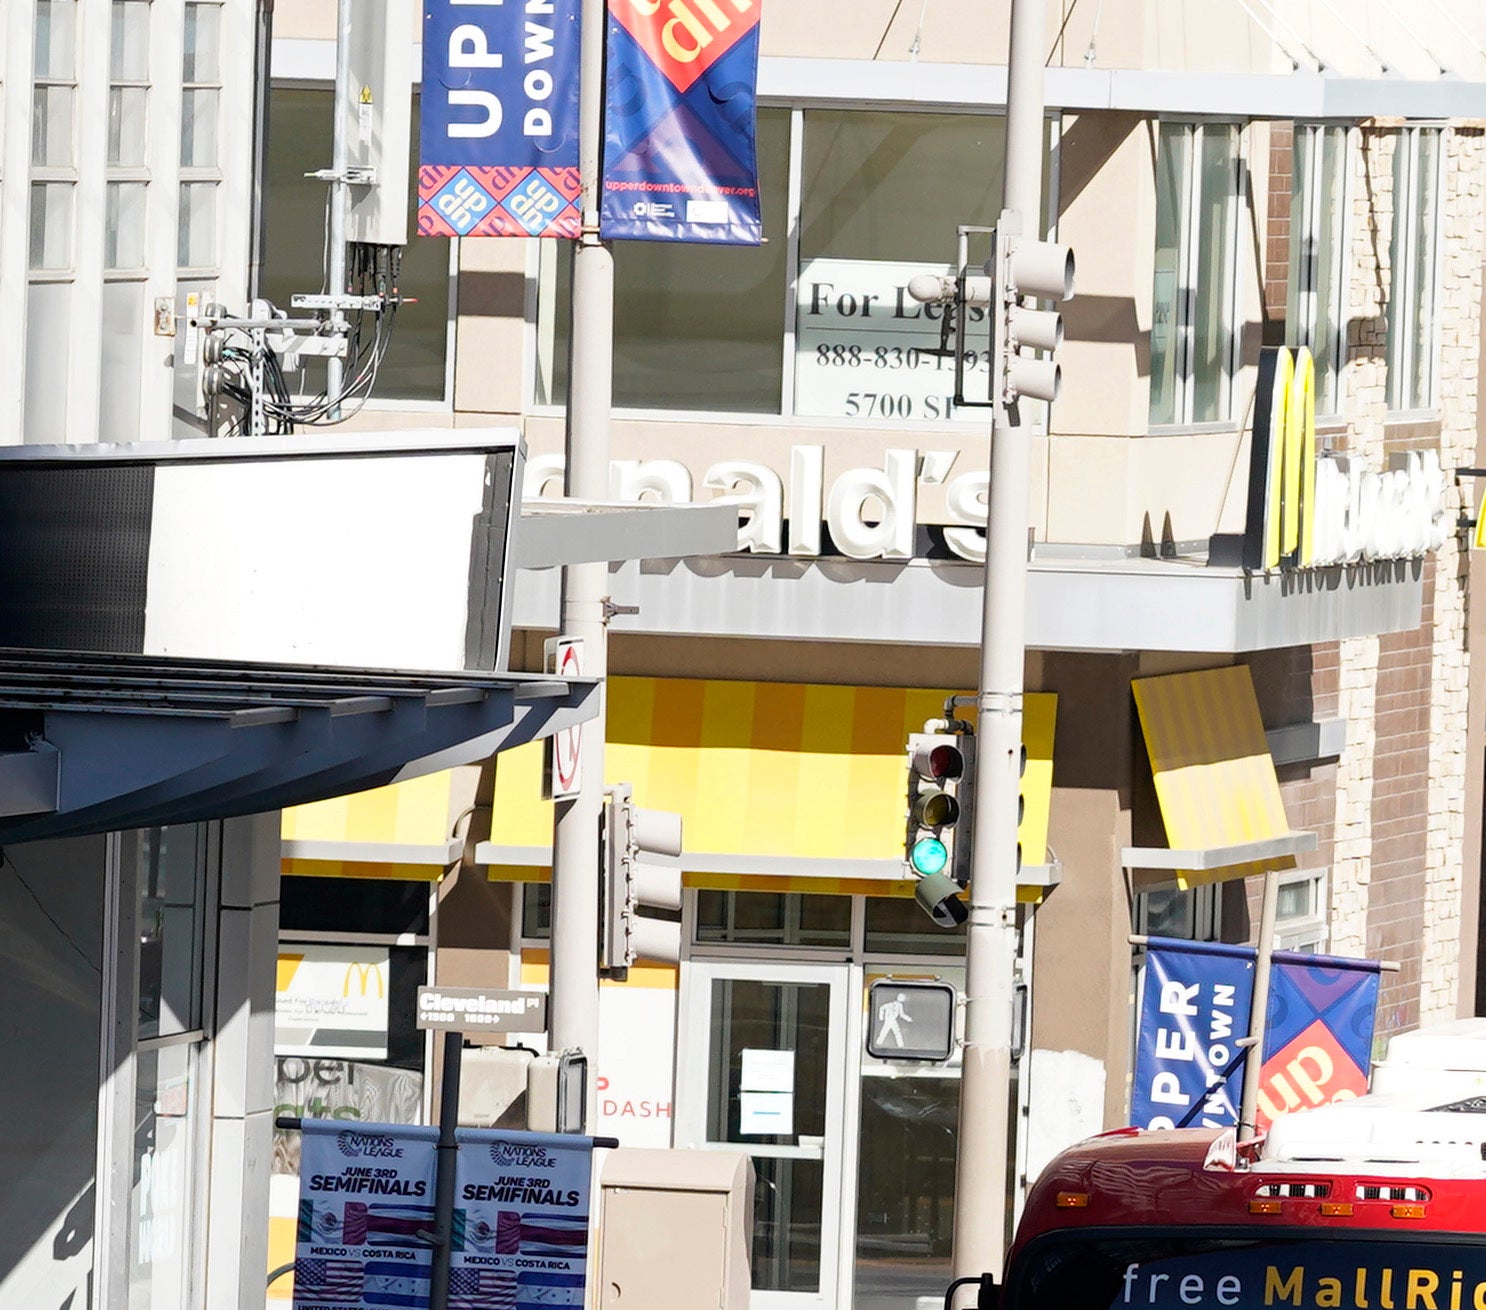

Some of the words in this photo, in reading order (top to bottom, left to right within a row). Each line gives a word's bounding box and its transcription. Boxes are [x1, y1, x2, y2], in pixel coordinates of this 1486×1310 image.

[807, 282, 878, 318] For
[892, 286, 990, 322] Les
[845, 392, 912, 418] 5700
[419, 992, 526, 1015] Cleveland
[603, 1100, 672, 1118] DASH
[363, 1146, 405, 1158] LEAGUE
[516, 1156, 557, 1168] LEAGUE
[341, 1166, 373, 1177] JUNE
[373, 1168, 398, 1179] 3RD
[309, 1174, 426, 1197] SEMIFINALS
[493, 1176, 526, 1186] JUNE
[526, 1177, 551, 1188] 3RD
[462, 1184, 580, 1207] SEMIFINALS
[310, 1246, 347, 1257] MEXICO
[362, 1249, 393, 1259] COSTA
[394, 1250, 416, 1260] RICA
[464, 1255, 501, 1266] MEXICO
[515, 1258, 546, 1268] COSTA
[547, 1259, 570, 1269] RICA
[1122, 1263, 1242, 1306] free
